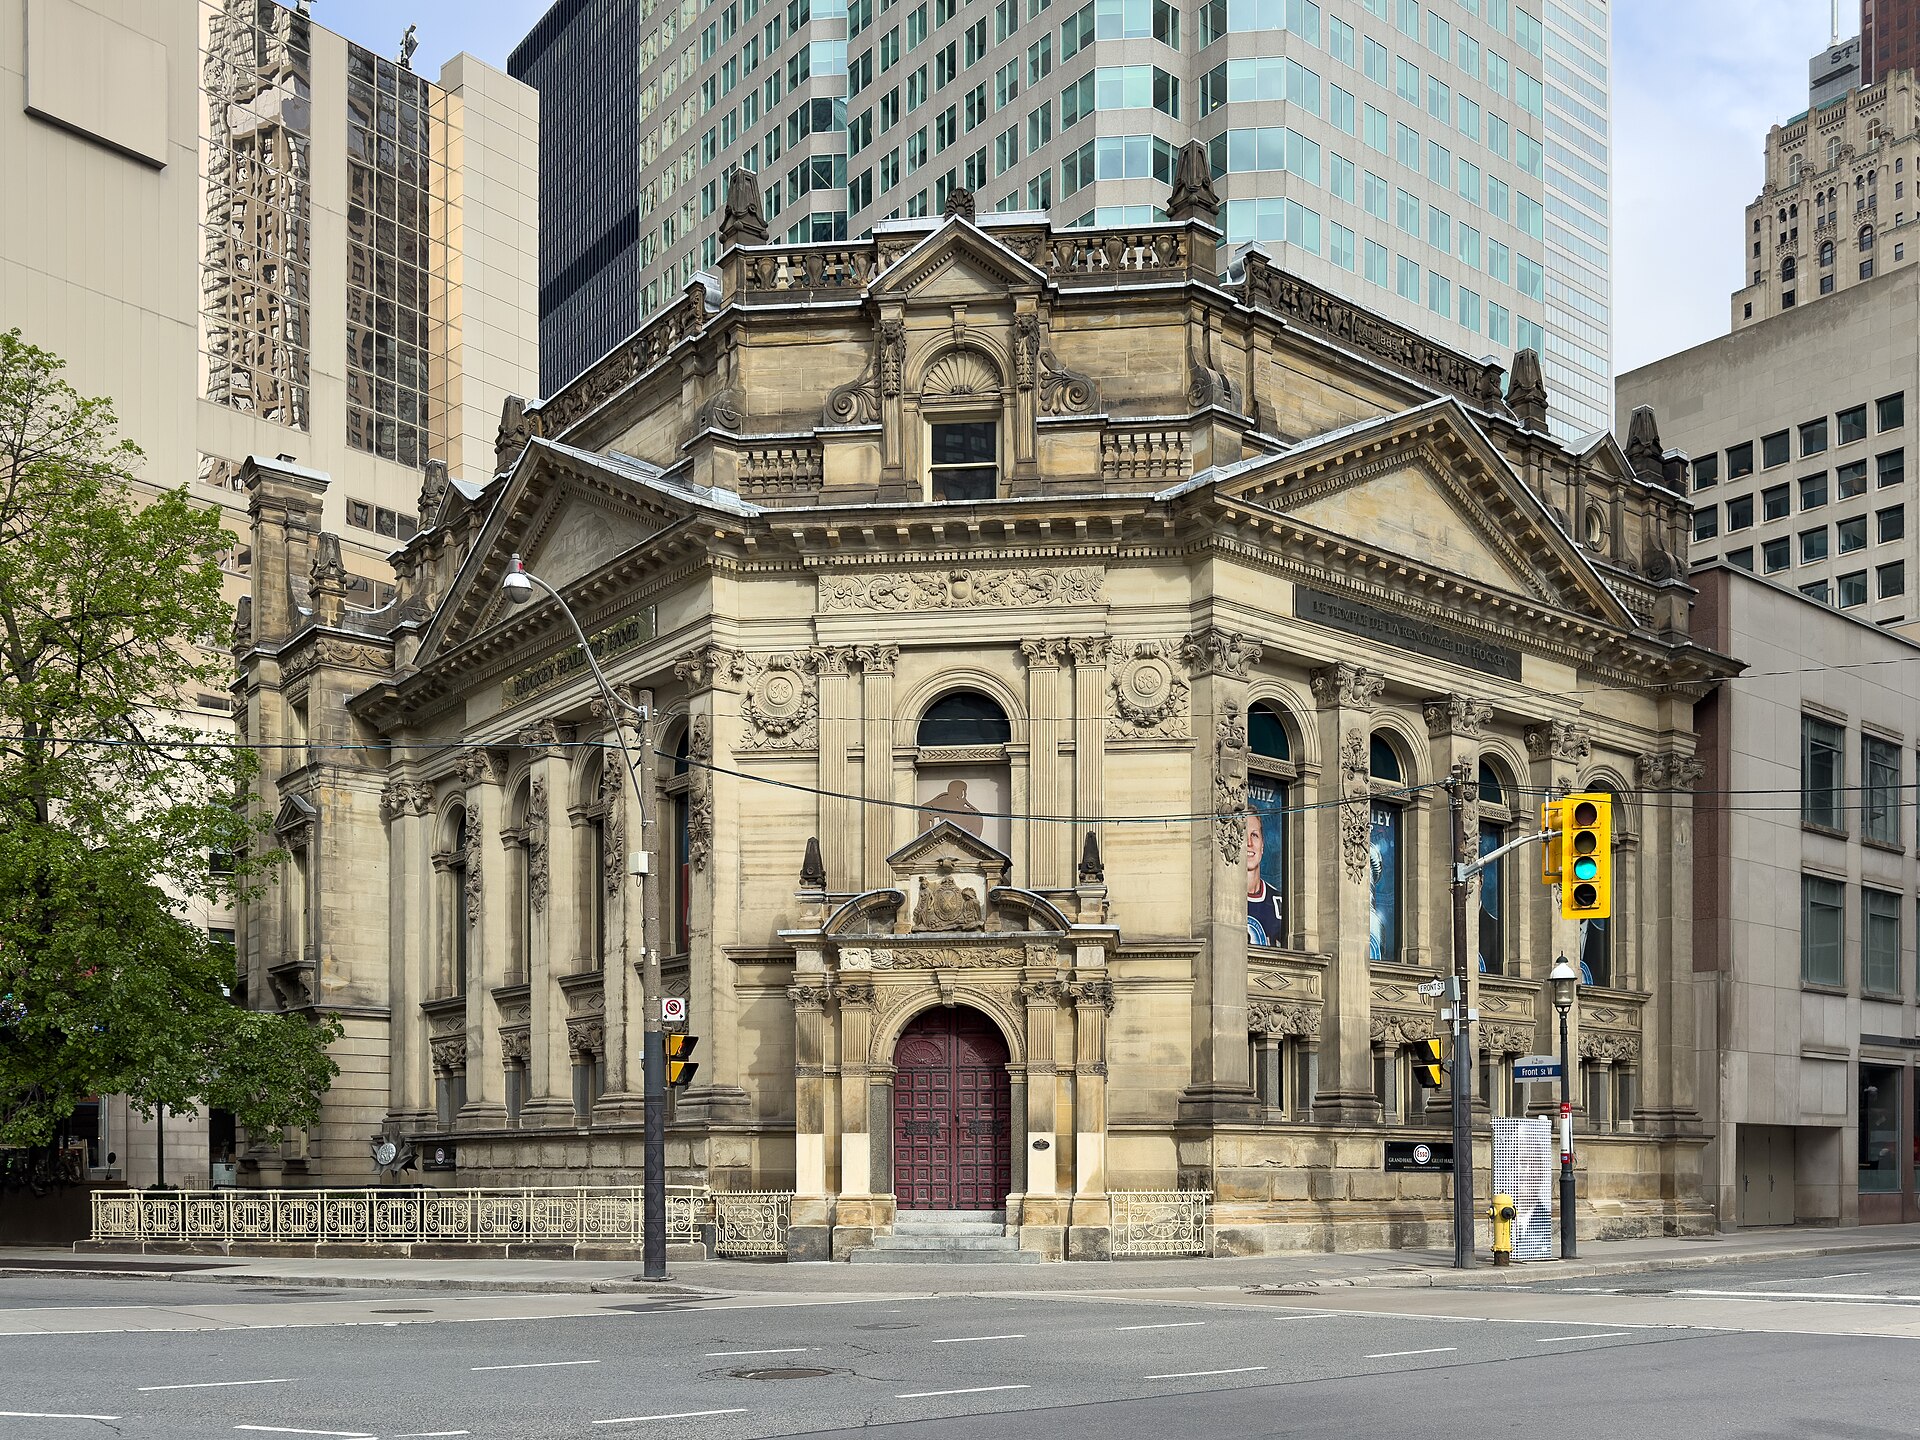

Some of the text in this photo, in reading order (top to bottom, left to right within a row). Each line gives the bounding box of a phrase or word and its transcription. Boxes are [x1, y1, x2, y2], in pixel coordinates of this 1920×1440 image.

[1455, 641, 1471, 656] DU
[1472, 646, 1509, 667] HOCKEY
[1420, 983, 1436, 992] FRONT
[1522, 1066, 1554, 1076] Front St W
